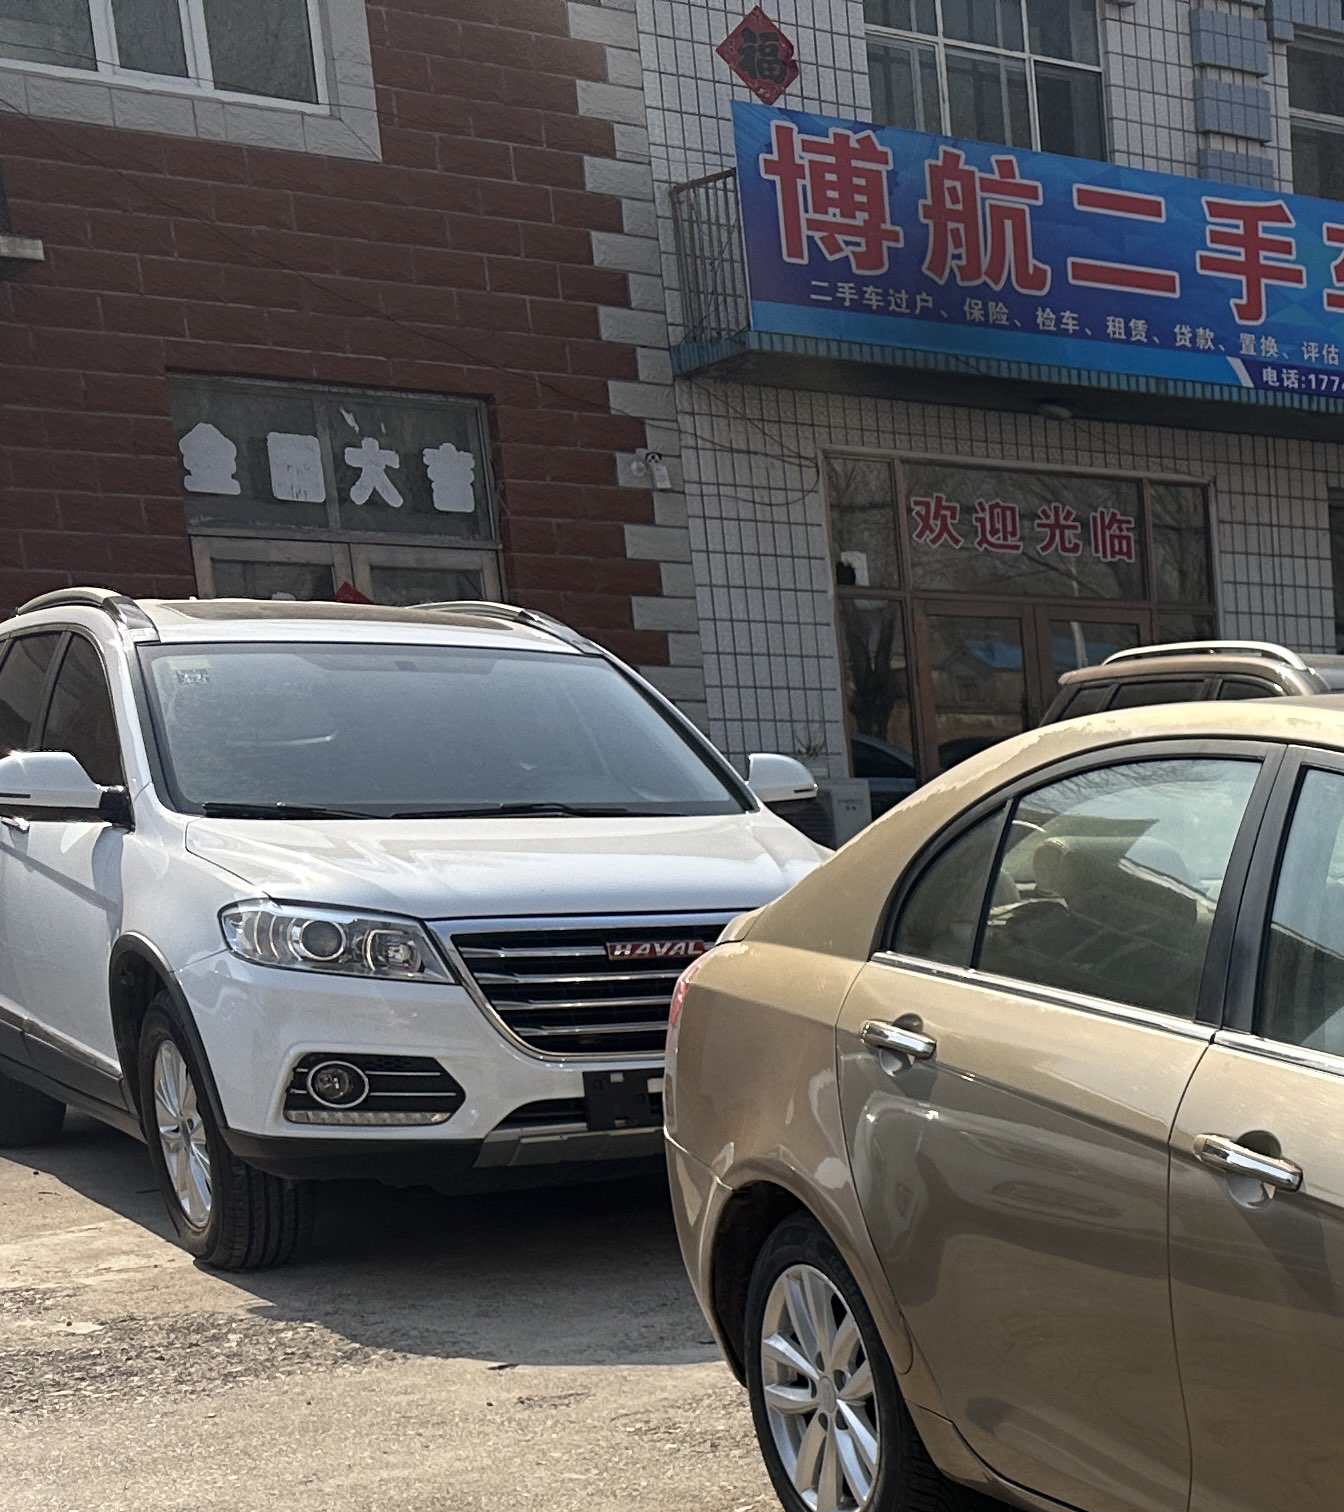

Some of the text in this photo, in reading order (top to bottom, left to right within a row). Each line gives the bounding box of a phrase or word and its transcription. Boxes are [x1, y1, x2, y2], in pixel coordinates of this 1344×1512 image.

[910, 493, 1136, 563] 欢迎光临
[614, 941, 704, 956] HAVAL
